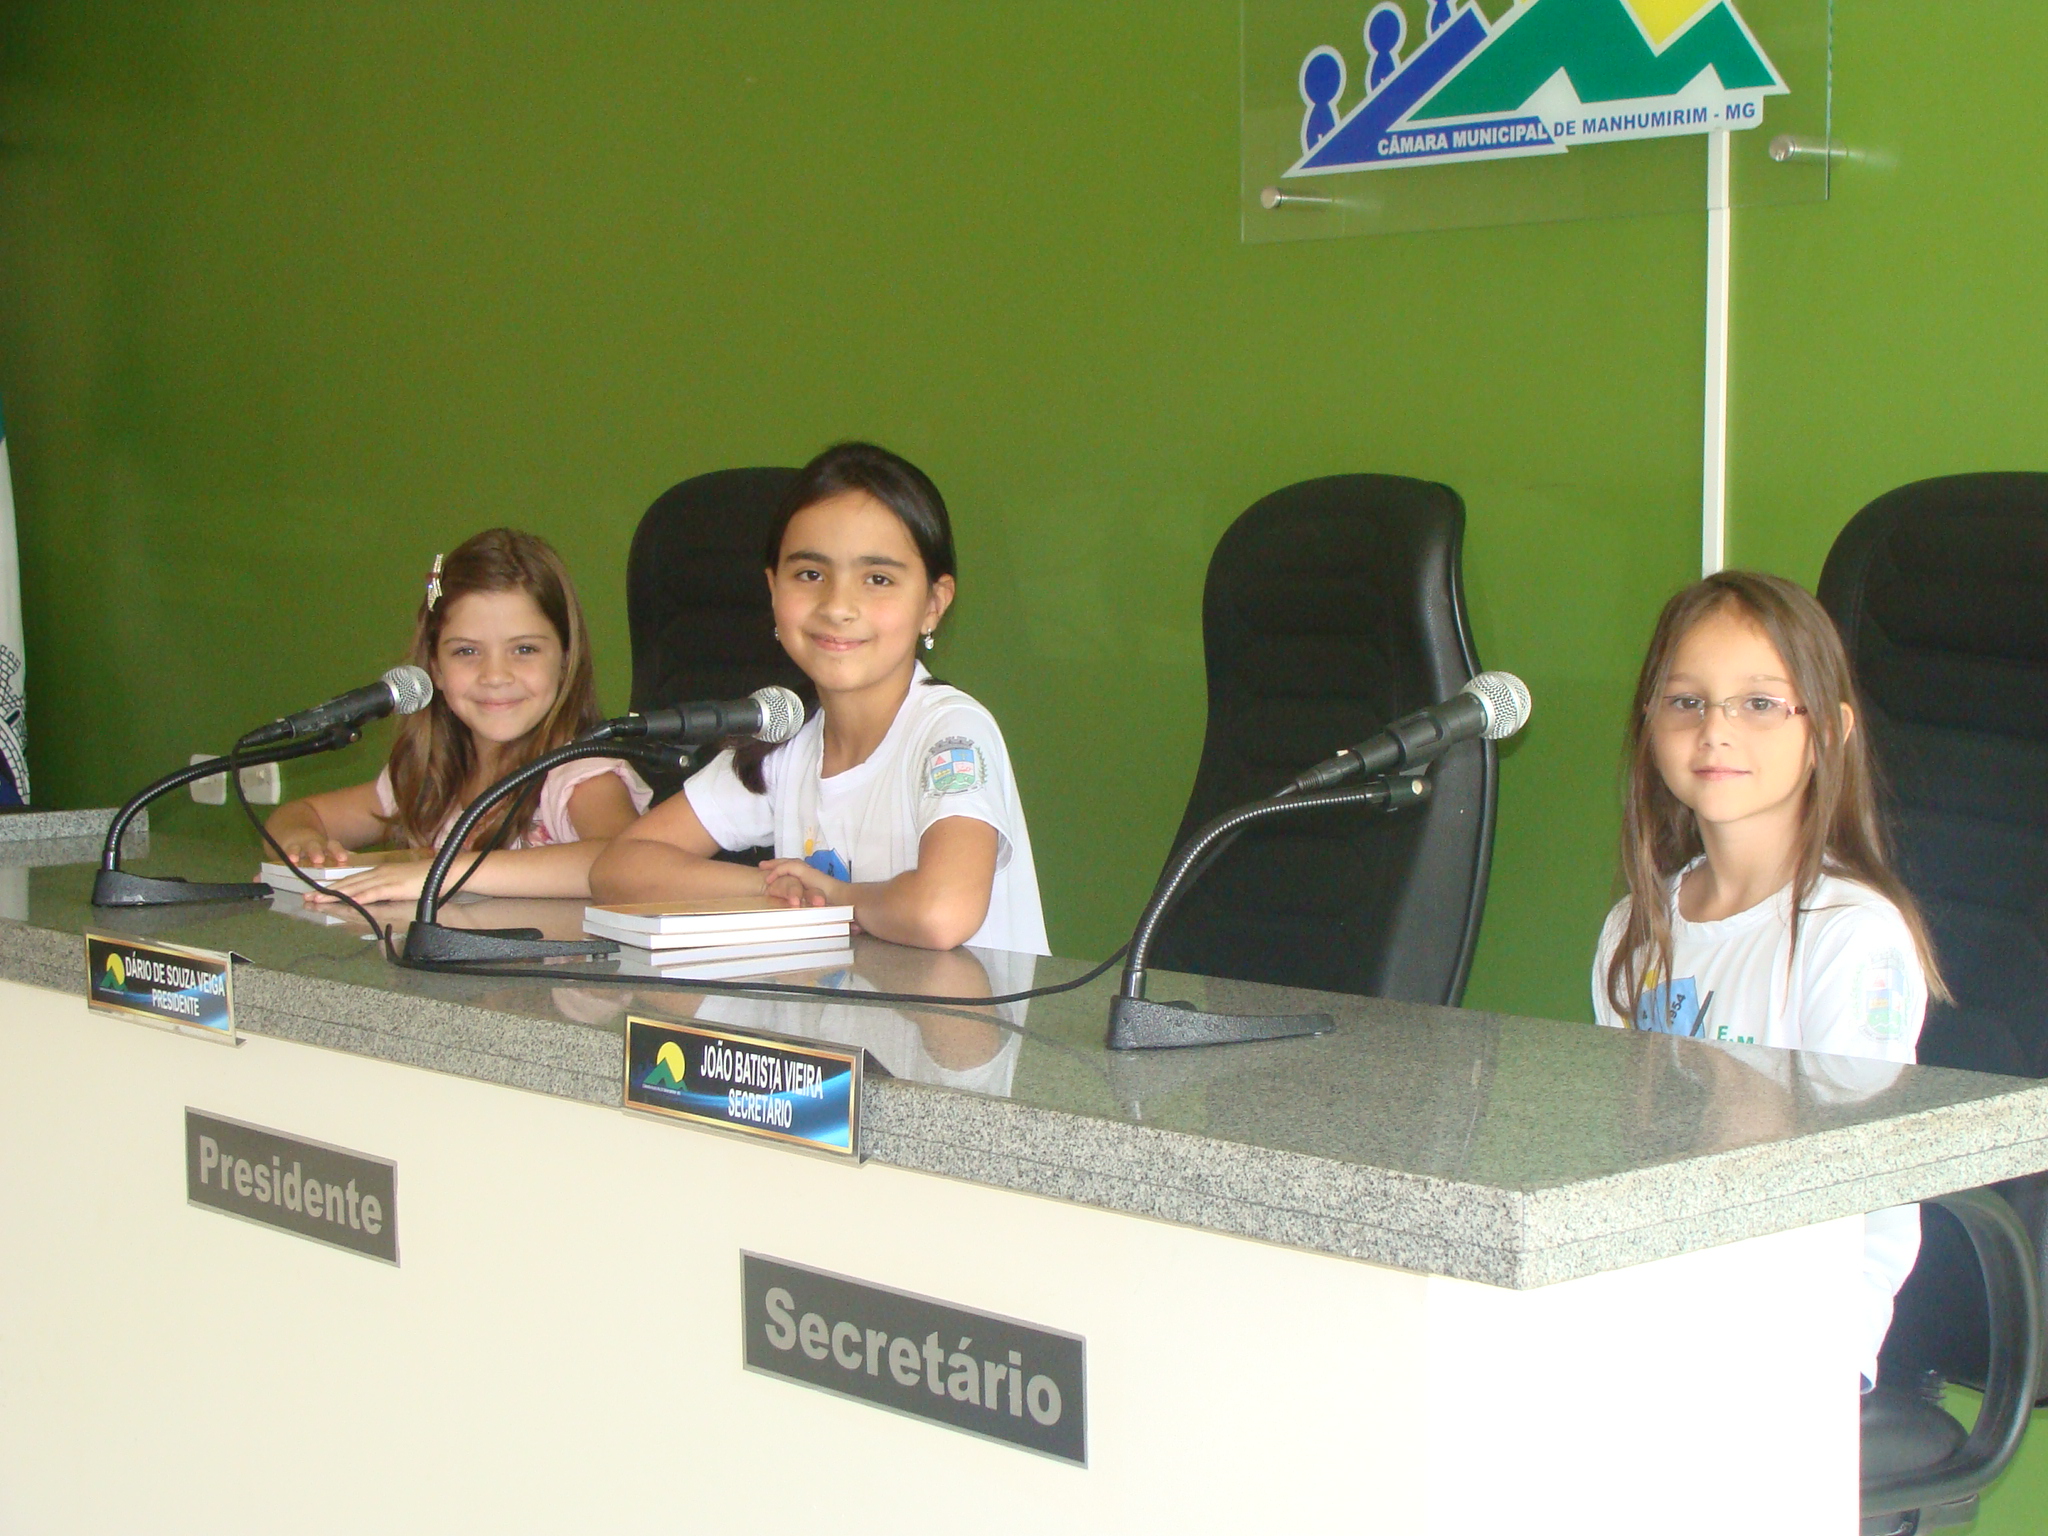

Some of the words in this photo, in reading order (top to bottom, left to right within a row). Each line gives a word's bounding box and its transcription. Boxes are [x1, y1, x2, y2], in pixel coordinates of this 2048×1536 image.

[1377, 133, 1448, 156] CÂMARA
[1453, 123, 1548, 148] MUNICIPAL
[1554, 120, 1576, 137] DE
[1582, 107, 1707, 134] MANHUMIRIM
[1725, 103, 1755, 121] MG
[125, 951, 152, 981] DÁRIO
[152, 962, 166, 984] DE
[166, 965, 197, 990] SOUZA
[197, 972, 225, 997] VEIGA
[152, 988, 200, 1017] PRESIDENTE
[700, 1040, 733, 1081] JOÃO
[735, 1051, 782, 1091] BATISTA
[785, 1060, 823, 1099] VIEIRA
[728, 1087, 792, 1129] SECRETÁRIO
[199, 1135, 383, 1235] Presidente
[764, 1287, 1062, 1426] Secretário
